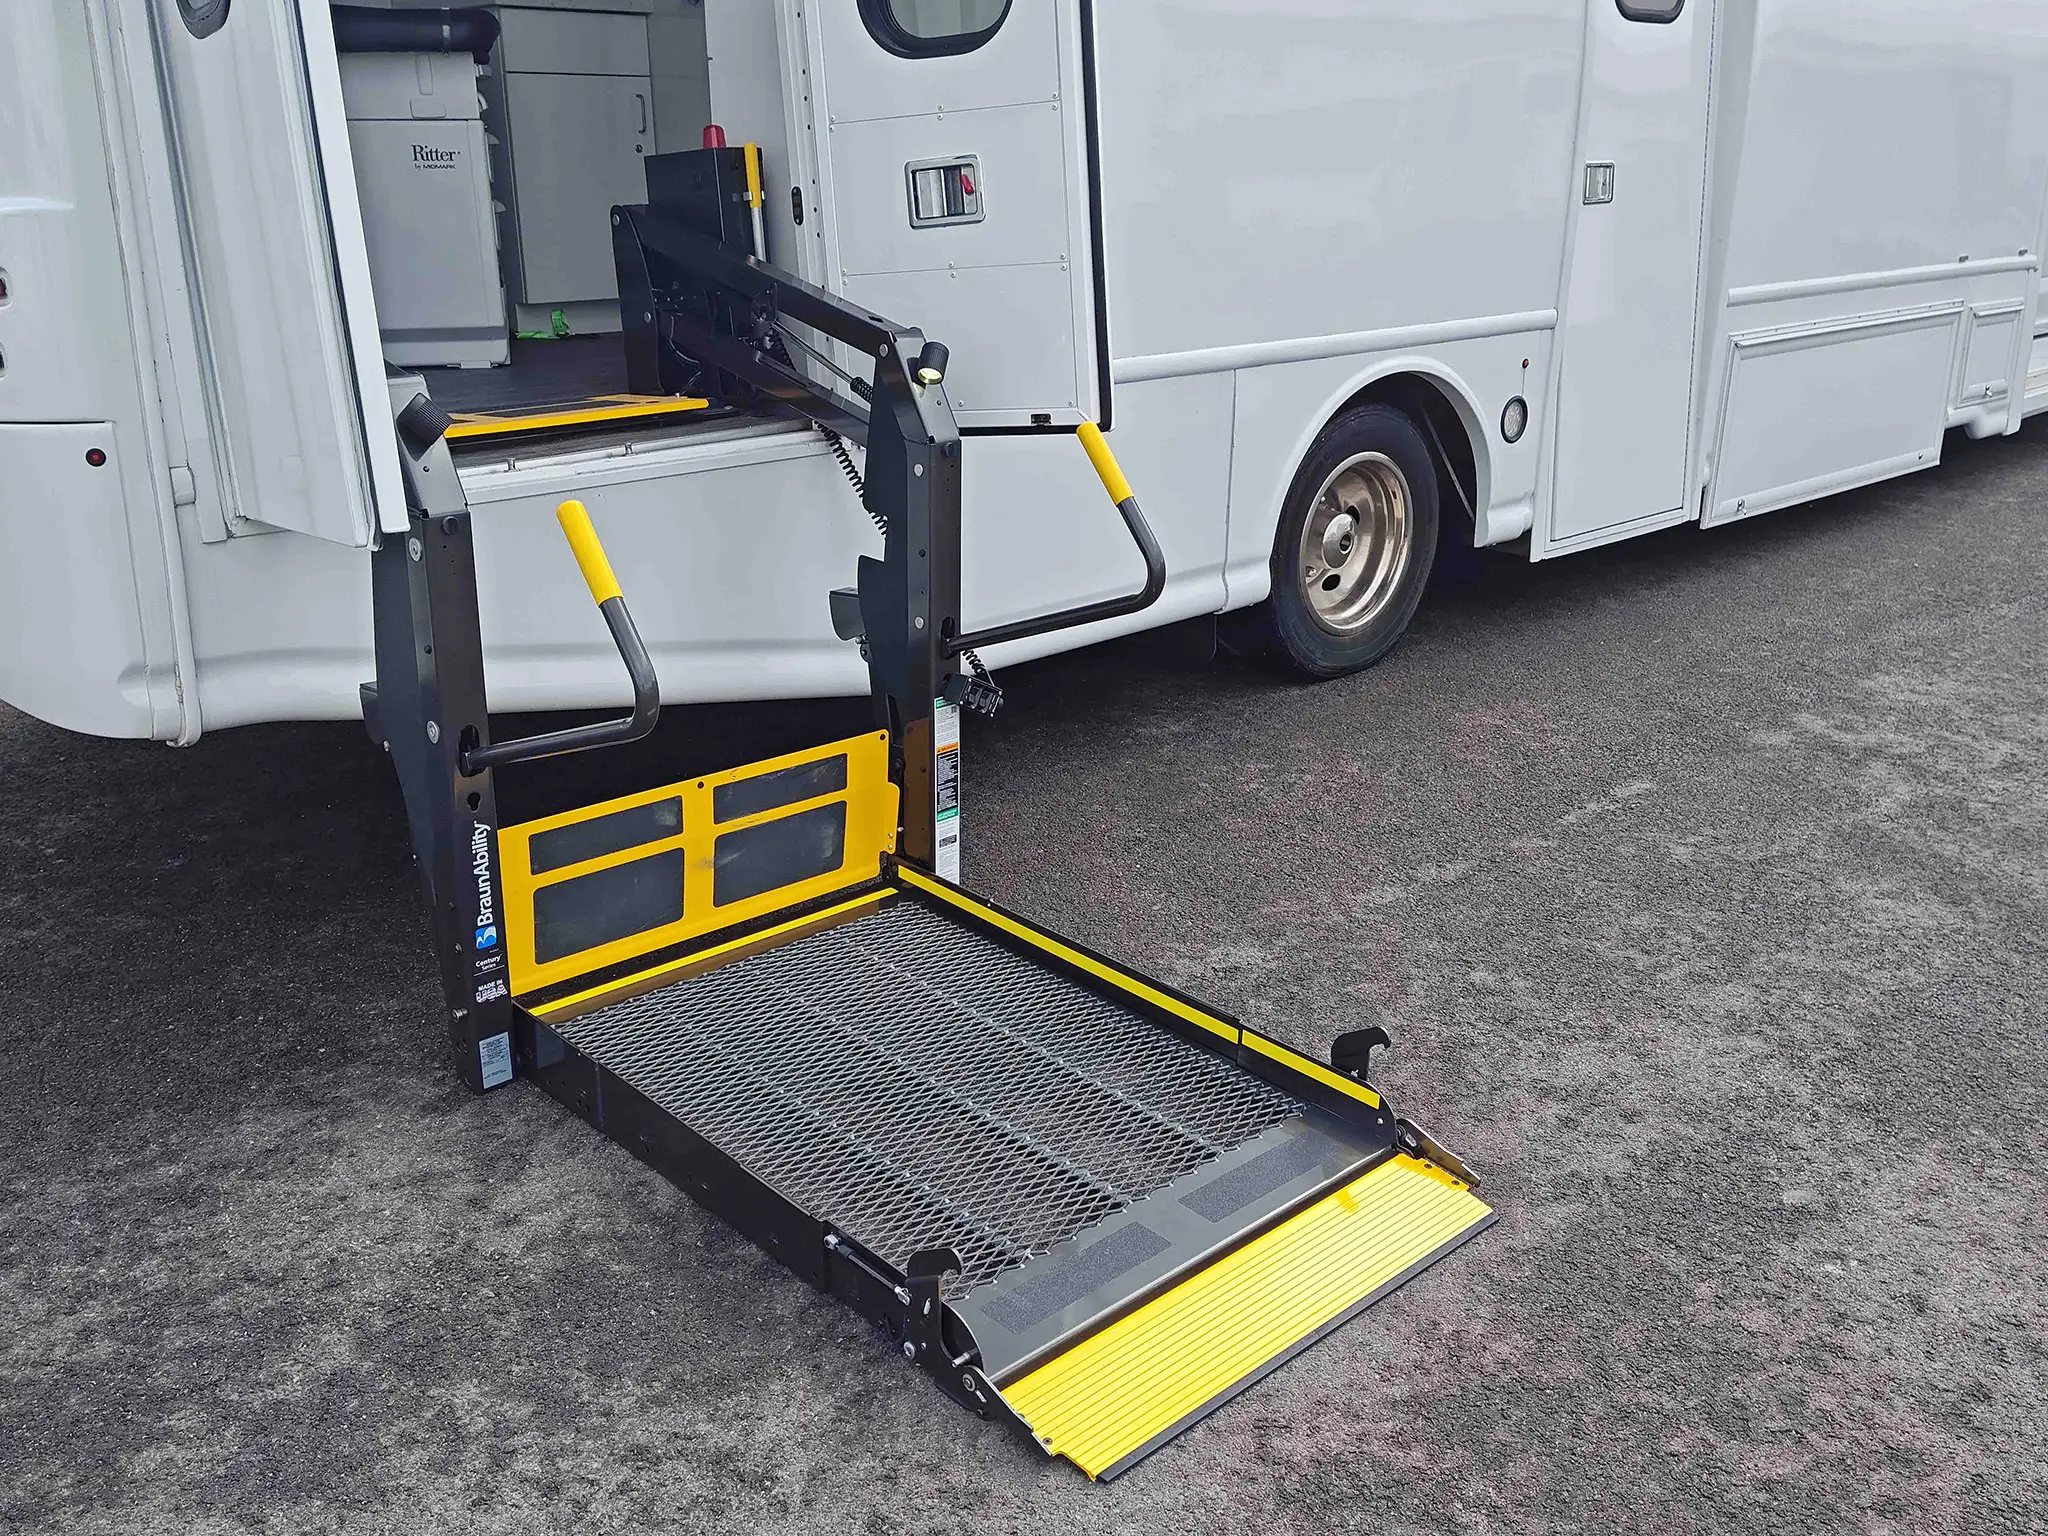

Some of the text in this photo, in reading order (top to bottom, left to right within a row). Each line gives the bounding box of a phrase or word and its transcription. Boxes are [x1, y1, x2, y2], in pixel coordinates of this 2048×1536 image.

[410, 144, 456, 162] Ritter
[414, 163, 421, 171] by
[471, 822, 493, 927] BraunAbility
[475, 955, 501, 967] Century
[478, 981, 496, 991] MADE
